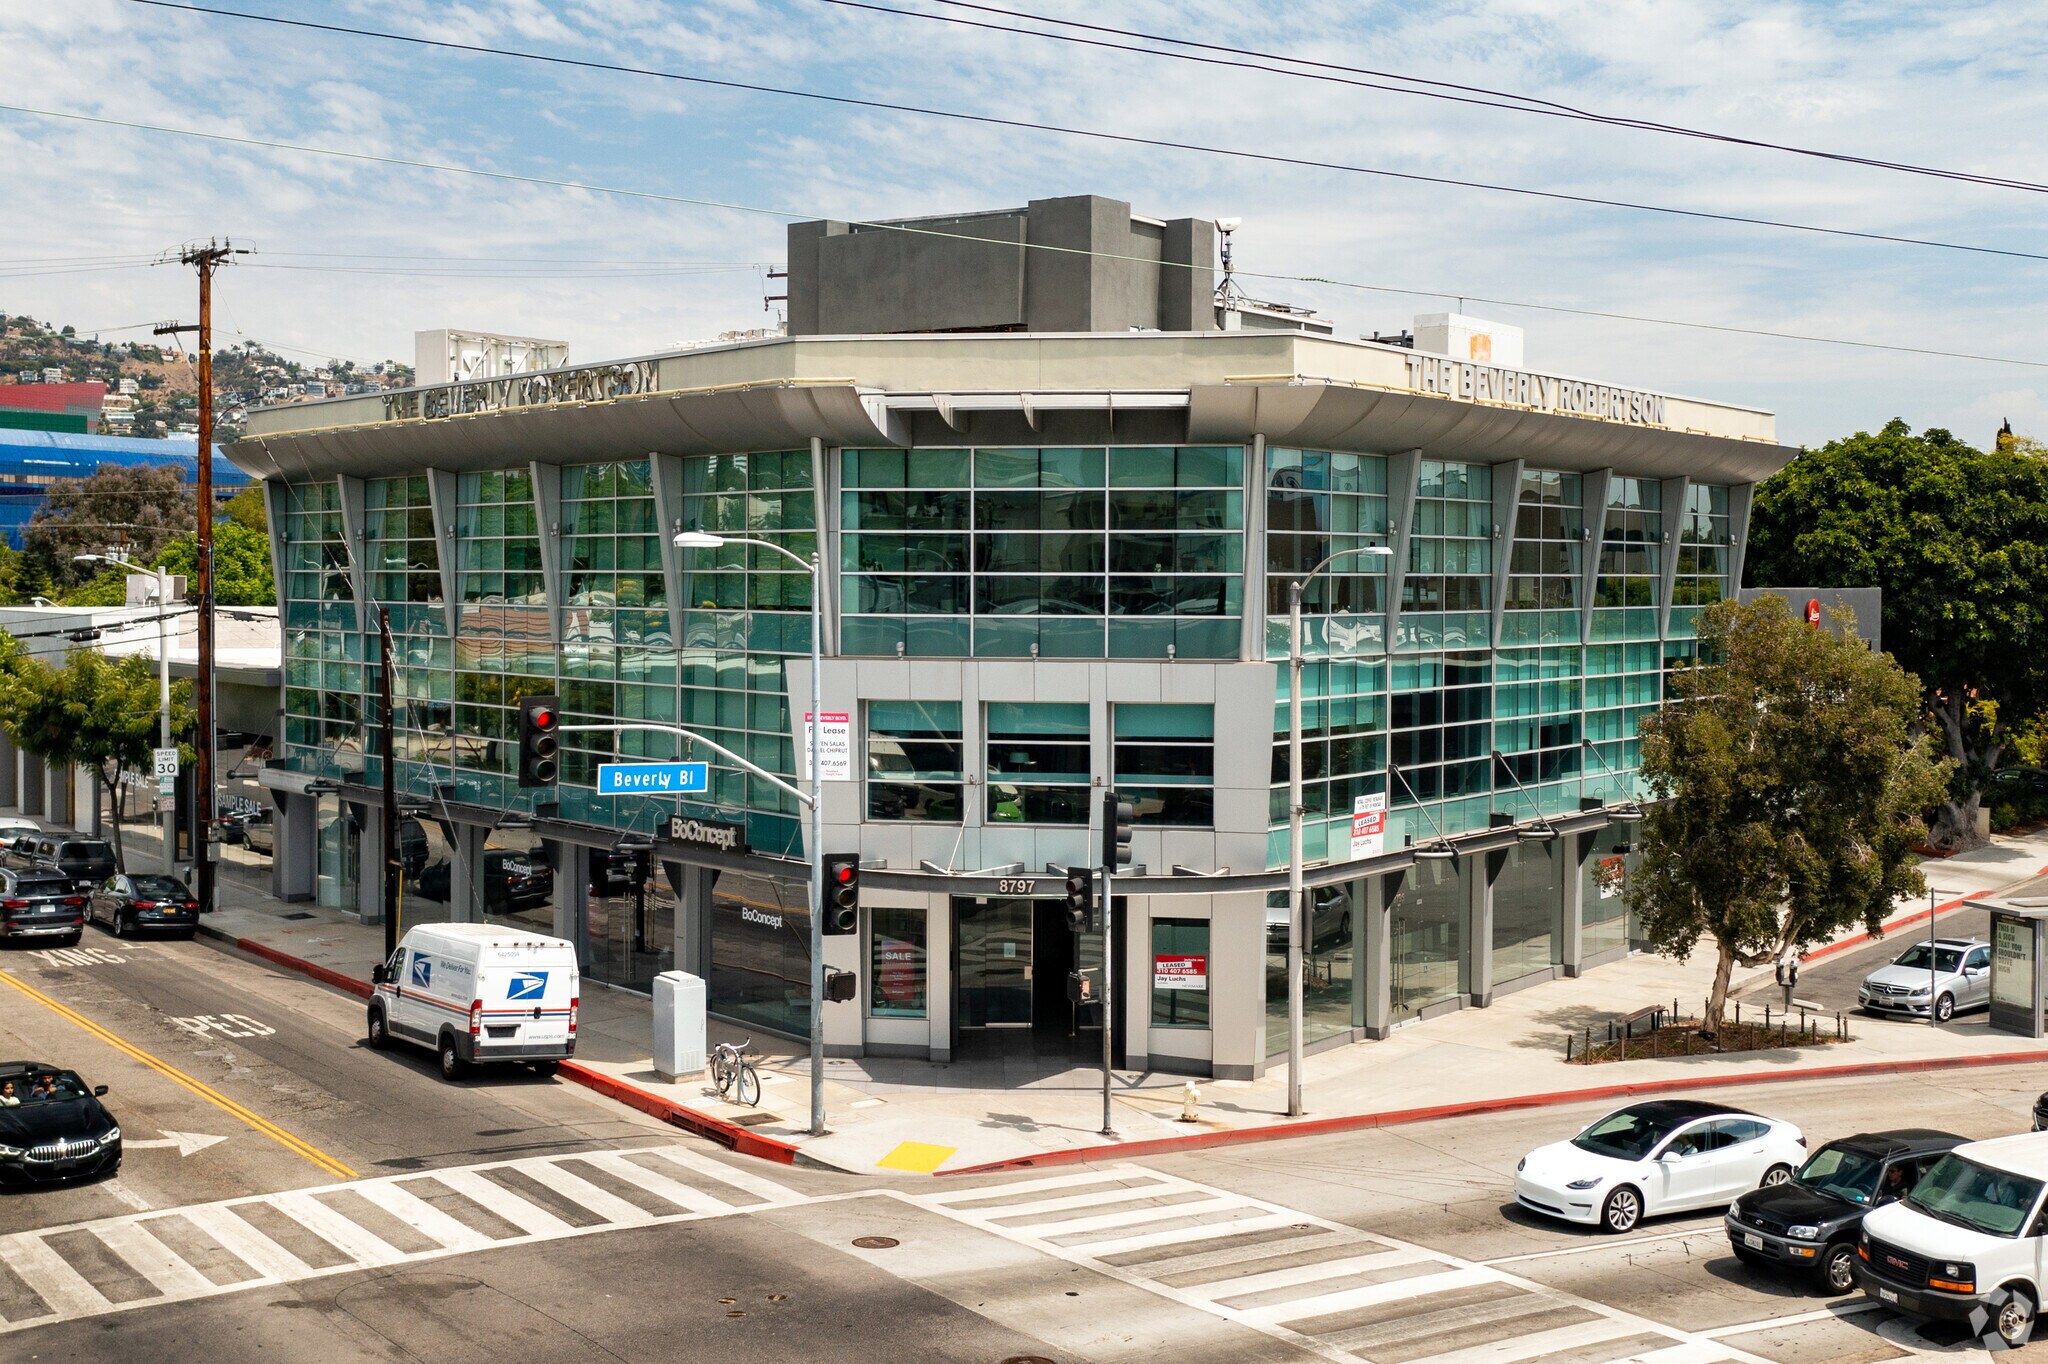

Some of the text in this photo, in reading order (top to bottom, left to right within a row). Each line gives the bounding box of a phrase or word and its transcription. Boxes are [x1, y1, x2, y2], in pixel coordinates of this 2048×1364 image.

[1407, 355, 1666, 424] THE BEVERLY ROBERTSON
[823, 726, 846, 734] Lease
[157, 763, 176, 774] 30
[614, 769, 694, 790] Beverly Bl
[217, 793, 262, 817] SAMPLE SALE
[1357, 816, 1377, 826] LEASED
[671, 817, 737, 850] BoConcept
[502, 858, 532, 877] BoConcept
[1000, 879, 1035, 893] 8797
[742, 906, 783, 930] BoConcept
[1998, 923, 2016, 934] THIS IS
[2003, 934, 2015, 942] SIGN
[1998, 940, 2022, 952] THAT YOU
[27, 947, 127, 967] XING
[885, 952, 911, 961] SALE
[1998, 948, 2026, 960] SHOULDN'T
[446, 962, 458, 971] Deliver
[457, 964, 465, 973] For
[169, 1013, 276, 1039] PED
[1886, 1255, 1908, 1270] GMC
